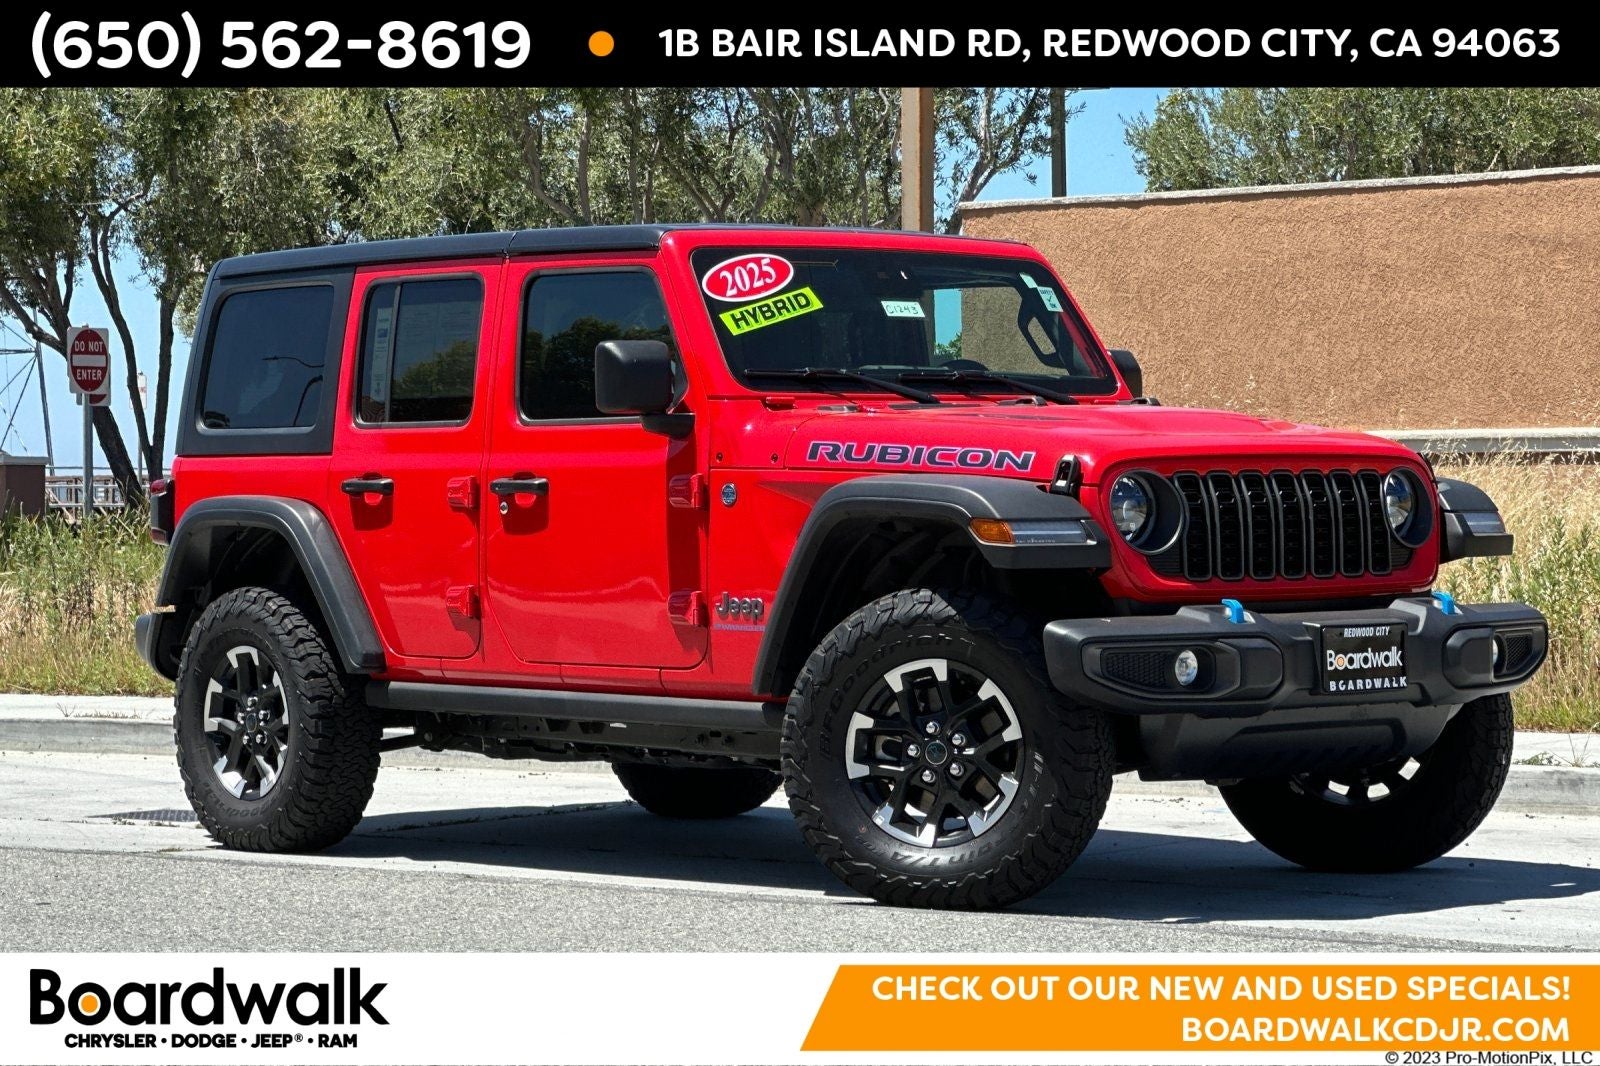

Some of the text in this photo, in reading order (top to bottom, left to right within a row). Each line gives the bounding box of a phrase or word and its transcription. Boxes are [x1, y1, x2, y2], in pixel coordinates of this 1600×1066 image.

[720, 258, 776, 297] 2025
[731, 292, 811, 329] HYBRID
[74, 341, 104, 352] DO NOT
[76, 369, 102, 381] ENTER
[806, 440, 1036, 472] RUBICON
[715, 591, 764, 620] Jeep
[1343, 626, 1390, 638] REDWOOD CITY
[1326, 646, 1403, 671] Boardwalk
